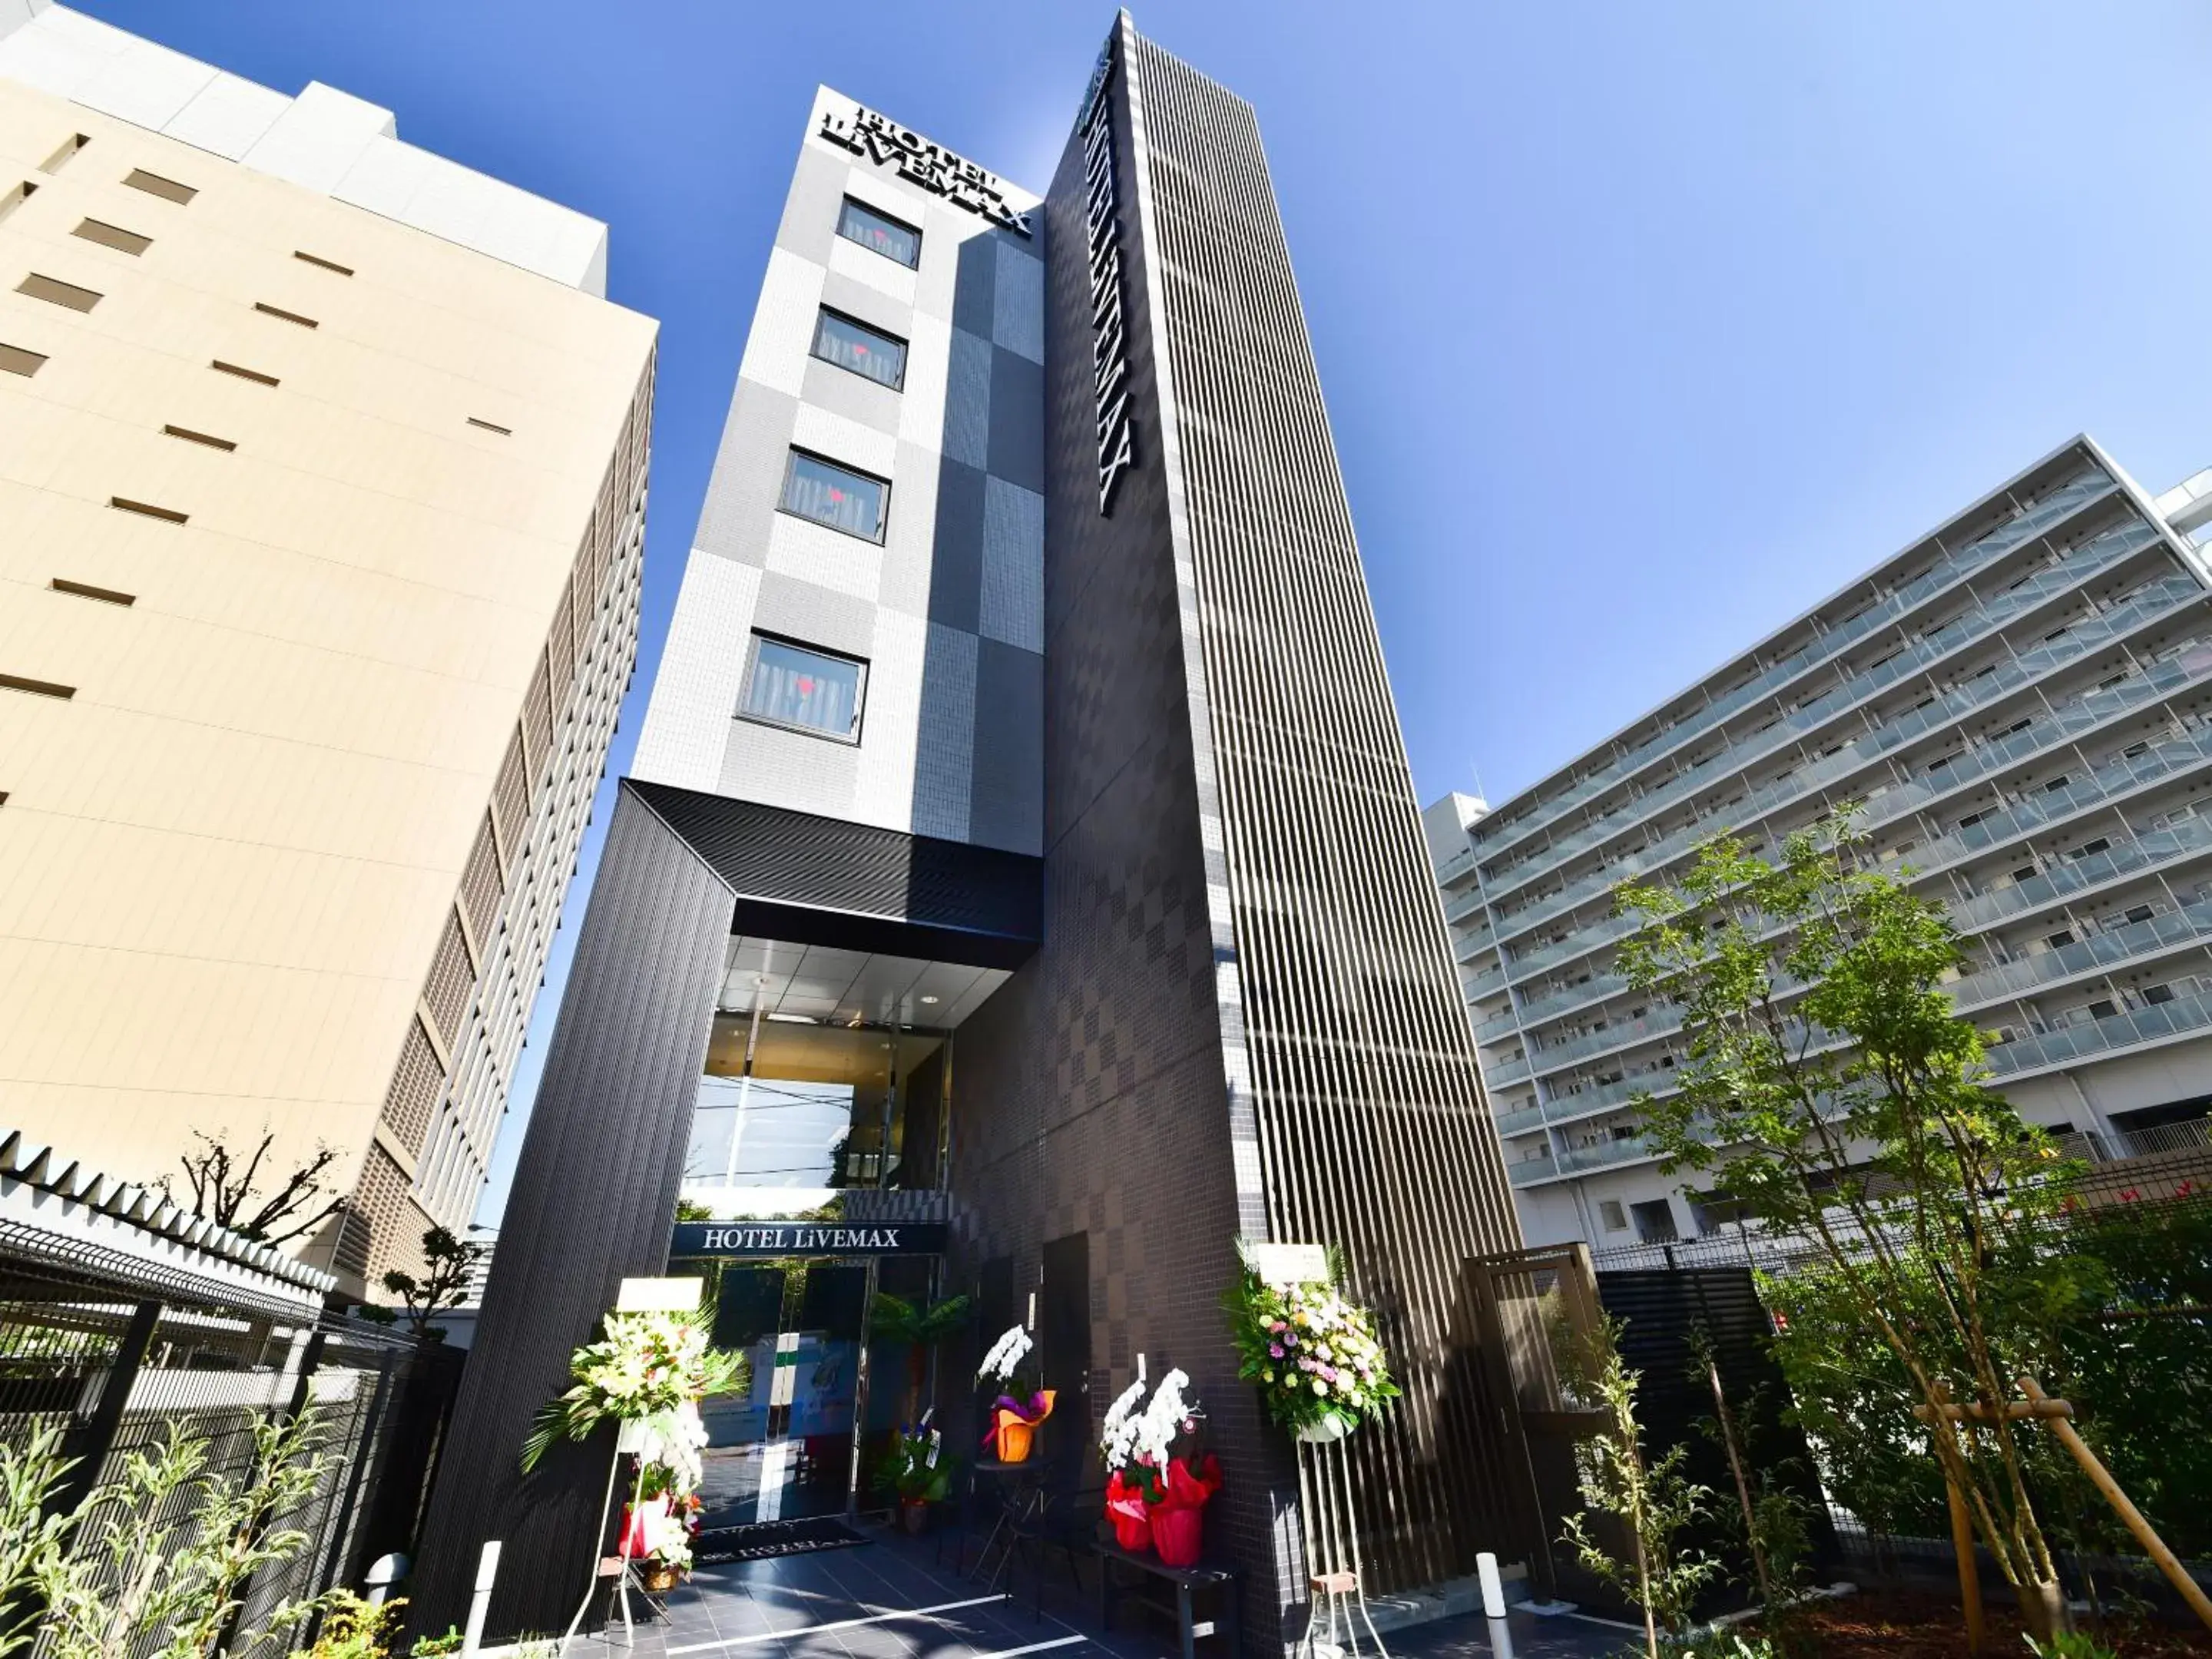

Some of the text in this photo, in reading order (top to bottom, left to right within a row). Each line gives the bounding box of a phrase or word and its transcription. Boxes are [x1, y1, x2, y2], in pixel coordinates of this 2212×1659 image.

[856, 107, 1004, 201] HOTEL
[1090, 219, 1131, 517] LiVEMAX
[703, 1229, 900, 1250] HOTEL LiVEMAX
